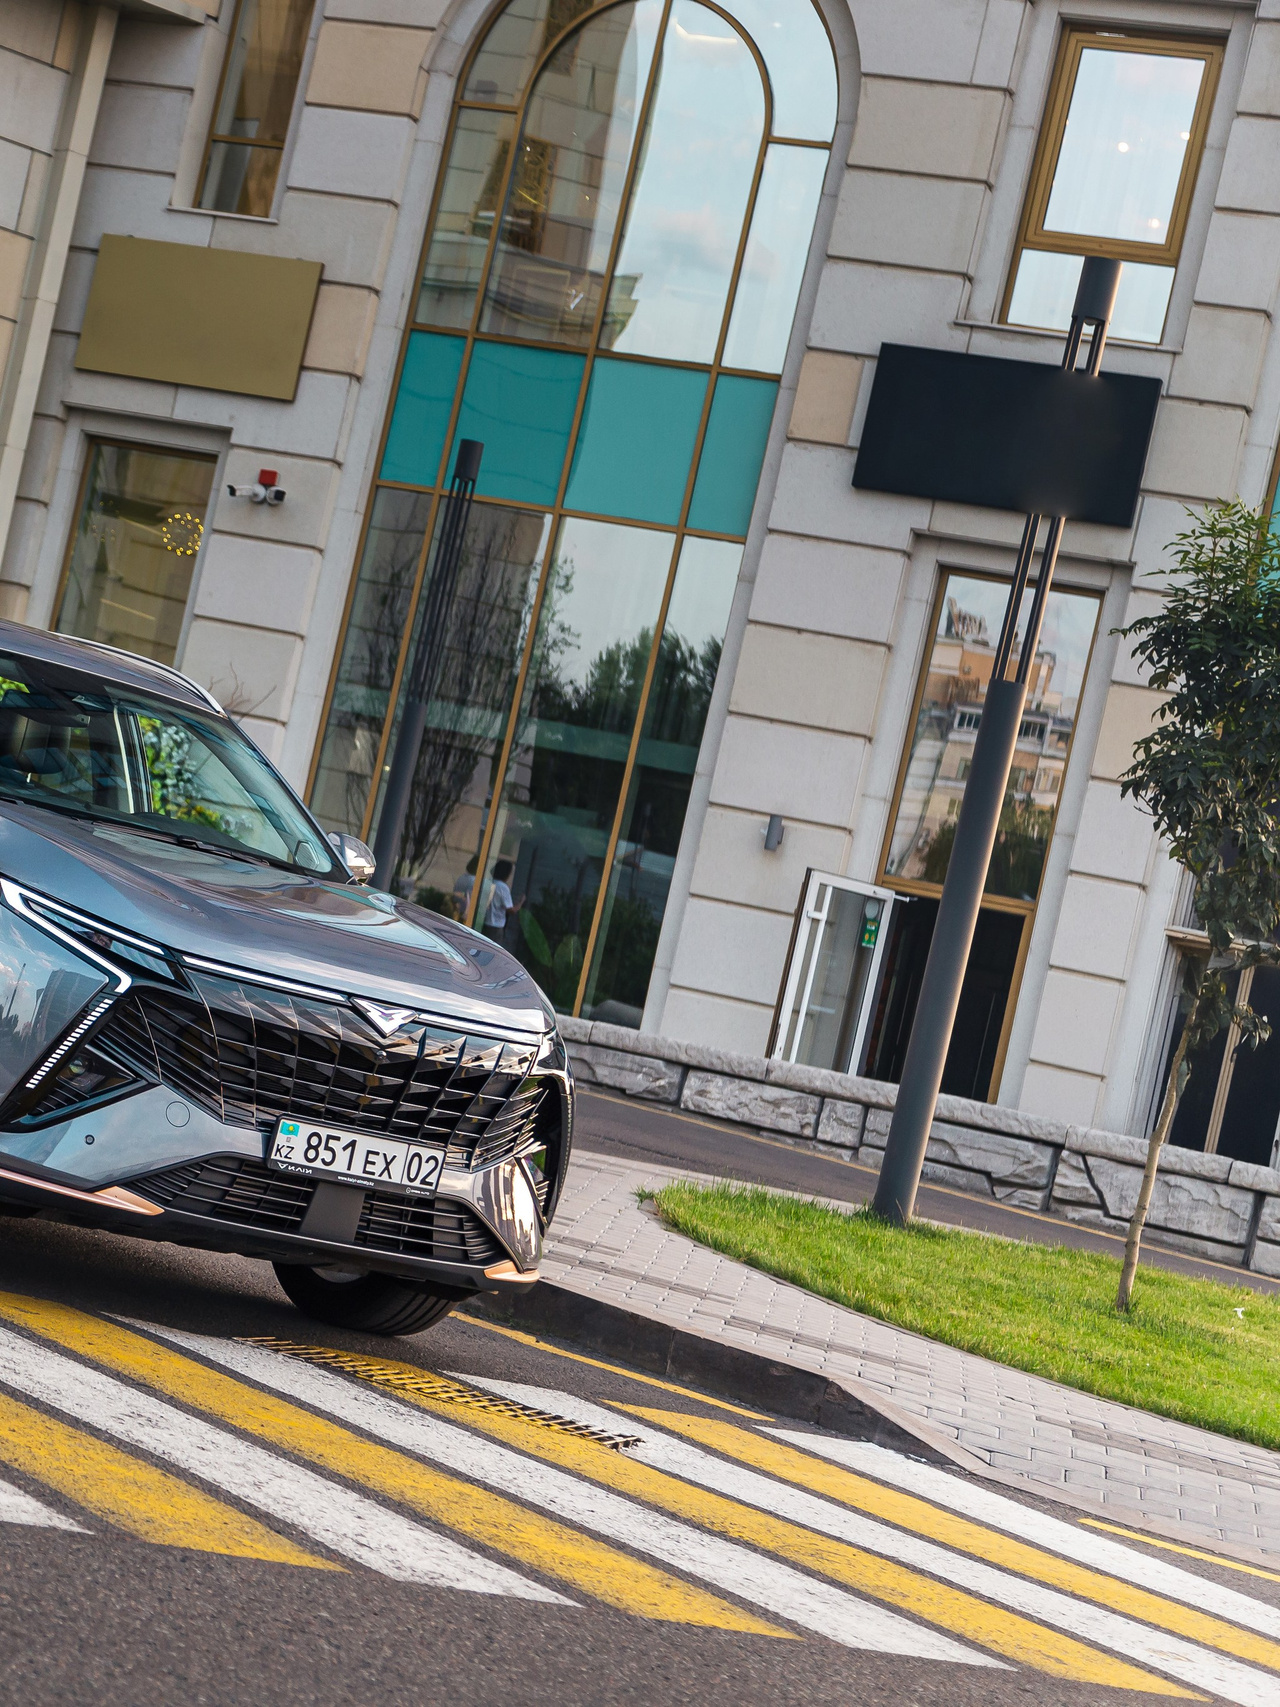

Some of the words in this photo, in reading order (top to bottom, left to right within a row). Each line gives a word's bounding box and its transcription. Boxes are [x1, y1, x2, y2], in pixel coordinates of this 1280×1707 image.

[274, 1143, 295, 1160] KZ
[303, 1131, 358, 1171] 851
[362, 1150, 398, 1180] EX
[406, 1152, 440, 1187] 02
